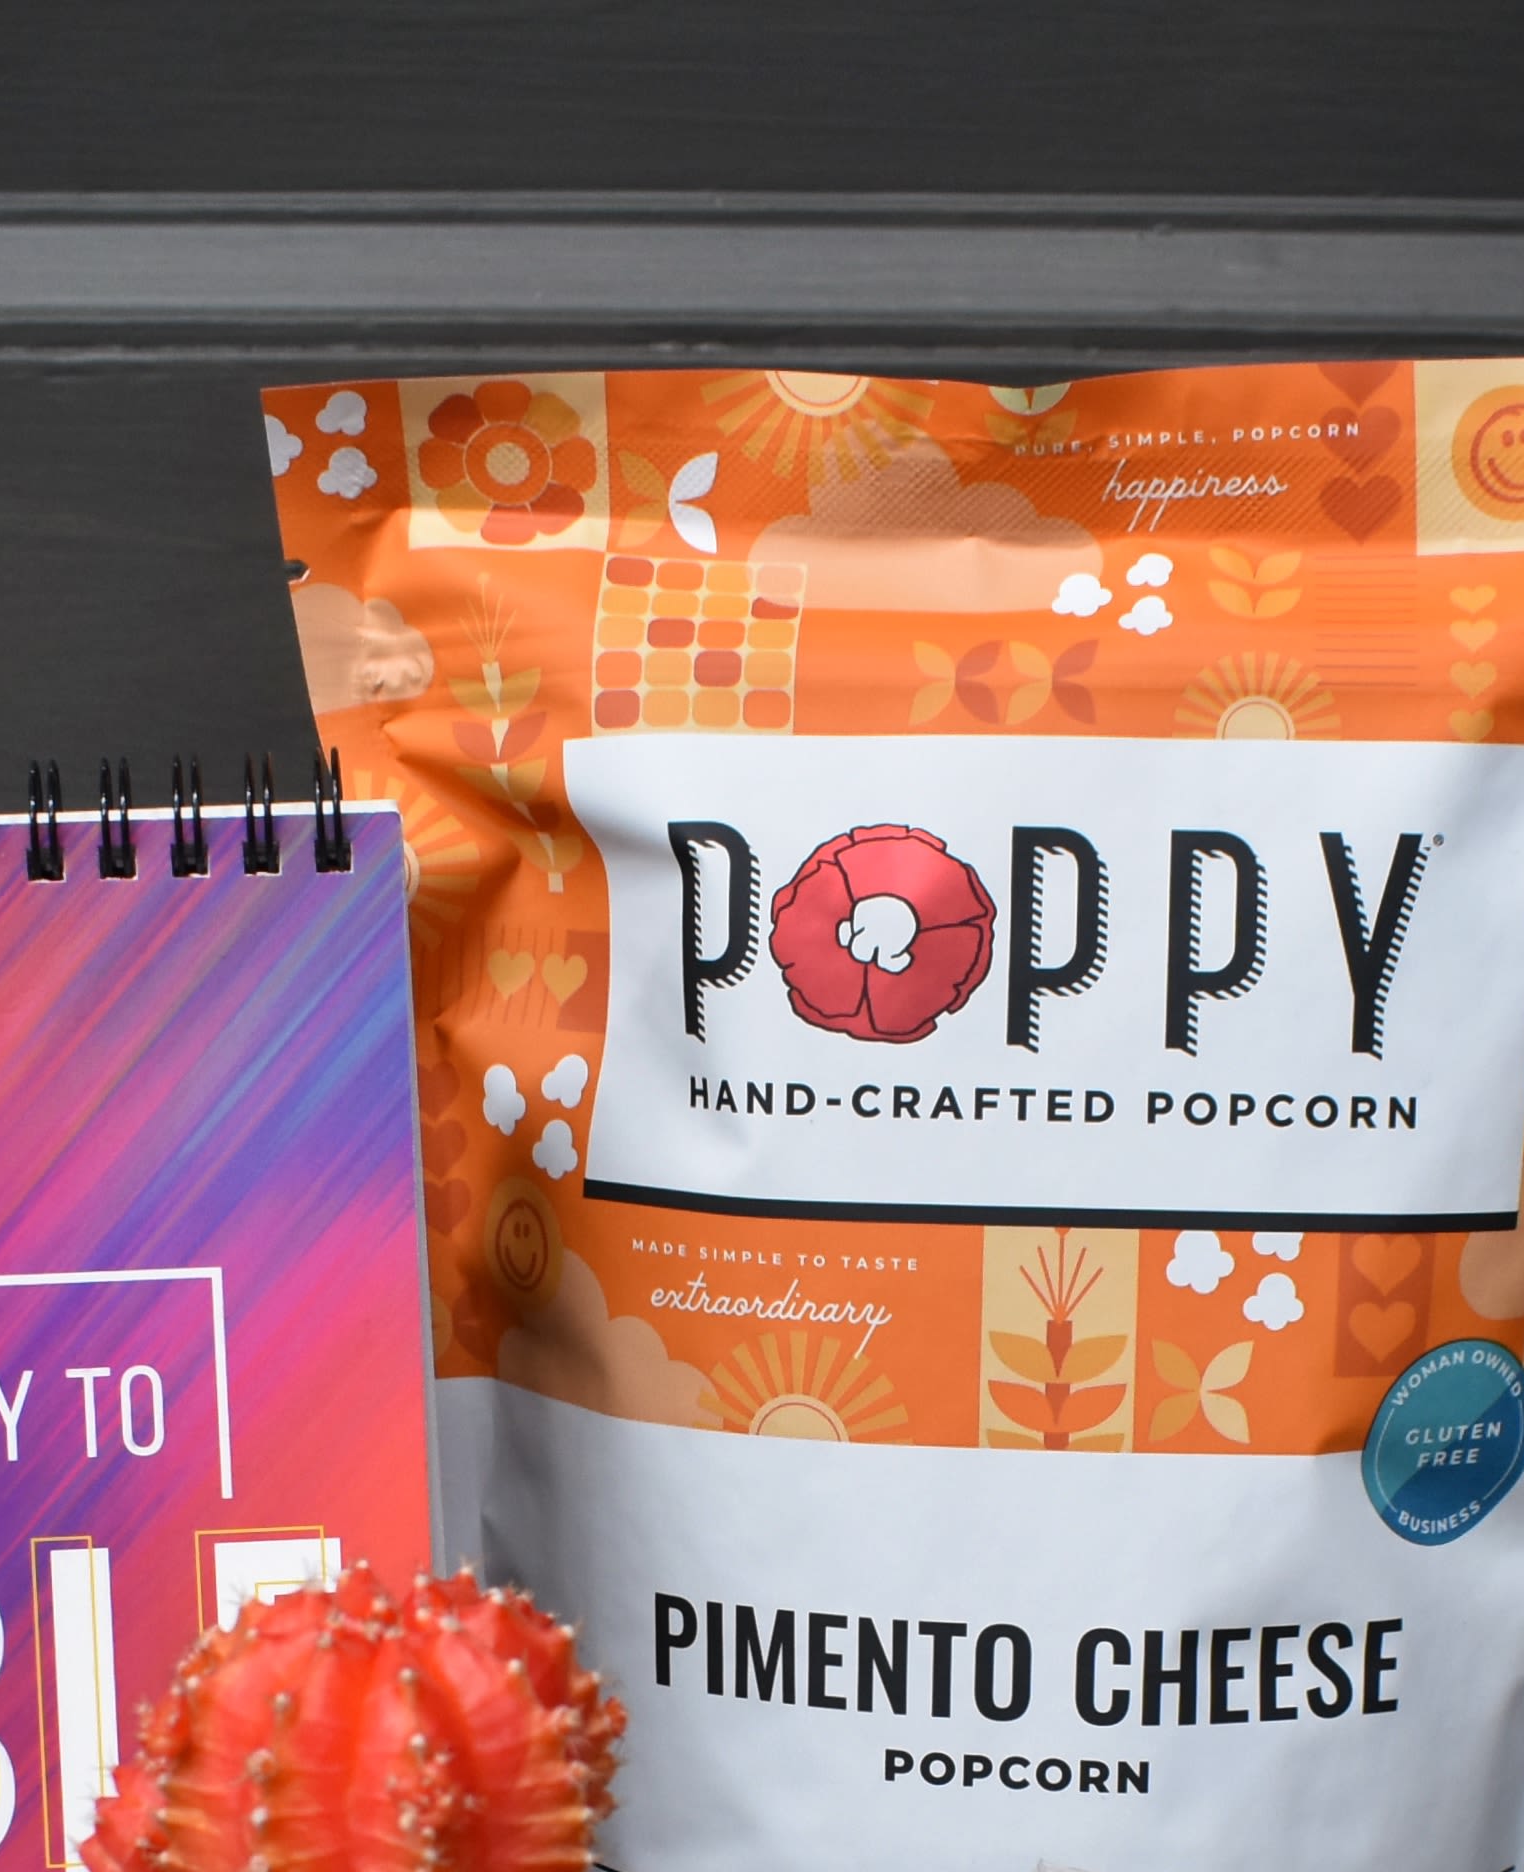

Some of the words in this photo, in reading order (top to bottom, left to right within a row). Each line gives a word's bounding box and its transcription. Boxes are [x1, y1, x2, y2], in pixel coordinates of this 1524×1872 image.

[1108, 428, 1218, 450] SIMPLE,
[1232, 421, 1361, 443] POPCORN
[1101, 458, 1289, 533] happiness
[687, 1074, 1116, 1124] HAND-CRAFTED
[1145, 1091, 1420, 1131] POPCORN
[632, 1238, 687, 1257] MADE
[699, 1246, 783, 1266] SIMPLE
[798, 1254, 826, 1268] TO
[841, 1255, 919, 1272] TASTE
[650, 1271, 893, 1360] extraordinary
[1391, 1349, 1466, 1406] WOMAN
[1471, 1349, 1523, 1397] OWNED
[64, 1364, 166, 1459] TO
[1405, 1421, 1503, 1446] GLUTEN
[1416, 1447, 1481, 1469] FREE
[1397, 1499, 1481, 1535] BUSINESS
[653, 1591, 1033, 1722] PIMENTO
[1075, 1616, 1404, 1727] CHEESE
[884, 1748, 1151, 1795] POPCORN
